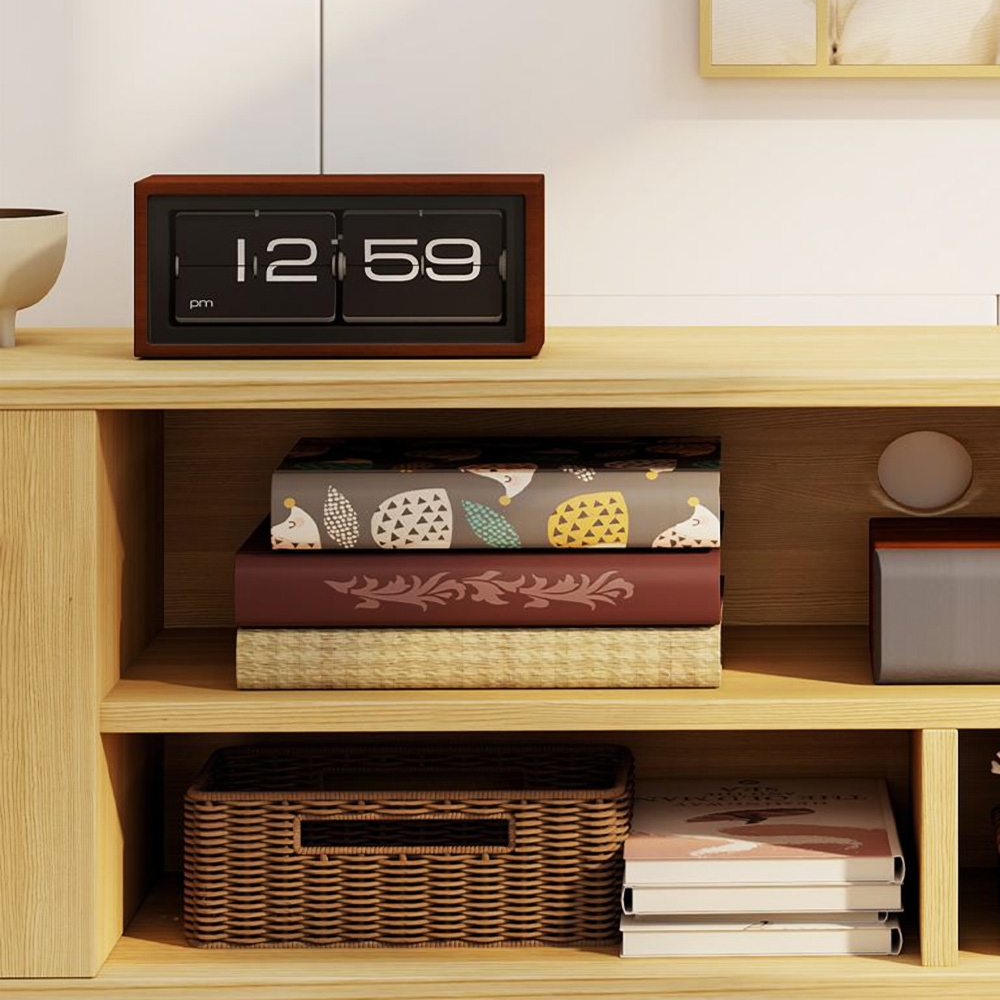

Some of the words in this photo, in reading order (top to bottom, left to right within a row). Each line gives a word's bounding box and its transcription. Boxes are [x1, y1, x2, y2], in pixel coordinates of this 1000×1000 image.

[237, 238, 318, 282] 12
[364, 238, 481, 282] 59
[189, 298, 214, 309] pm
